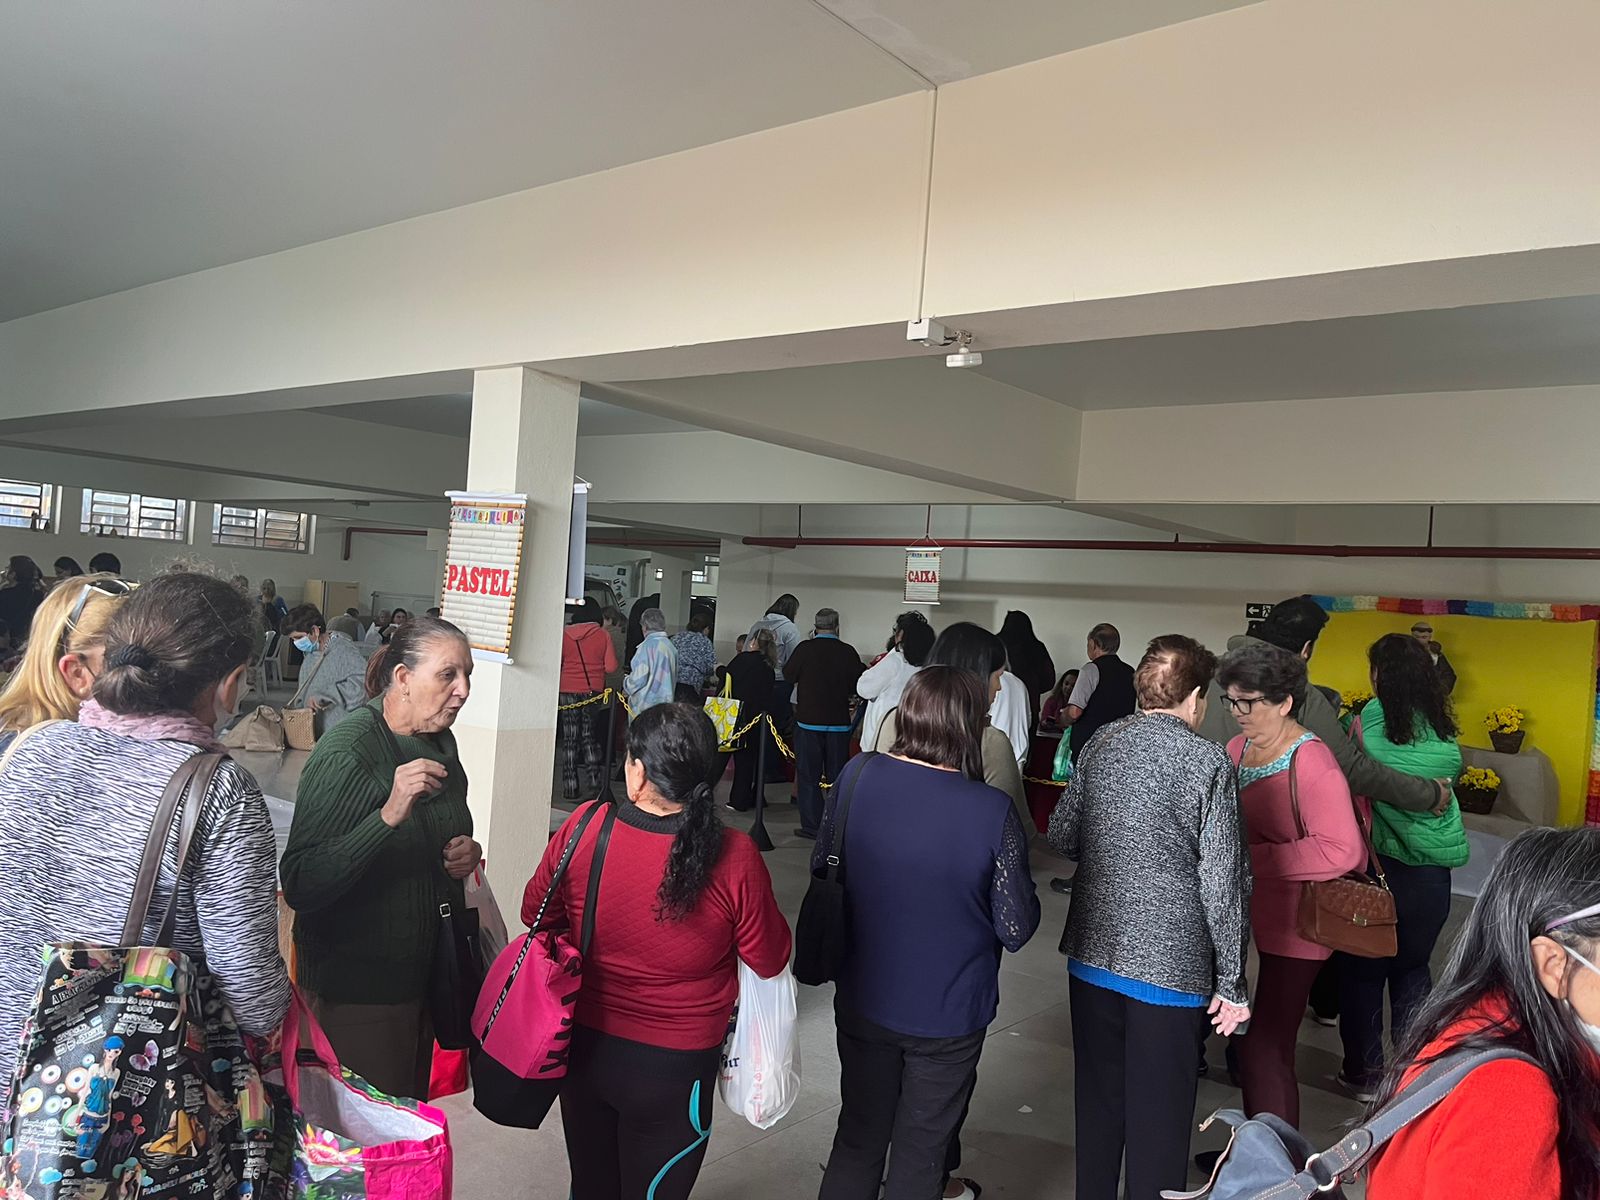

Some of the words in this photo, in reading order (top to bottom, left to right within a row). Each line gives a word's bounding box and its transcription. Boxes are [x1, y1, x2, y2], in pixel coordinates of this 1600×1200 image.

[446, 565, 512, 597] PASTEL
[908, 570, 937, 583] CAIXA
[487, 987, 507, 1030] PINK
